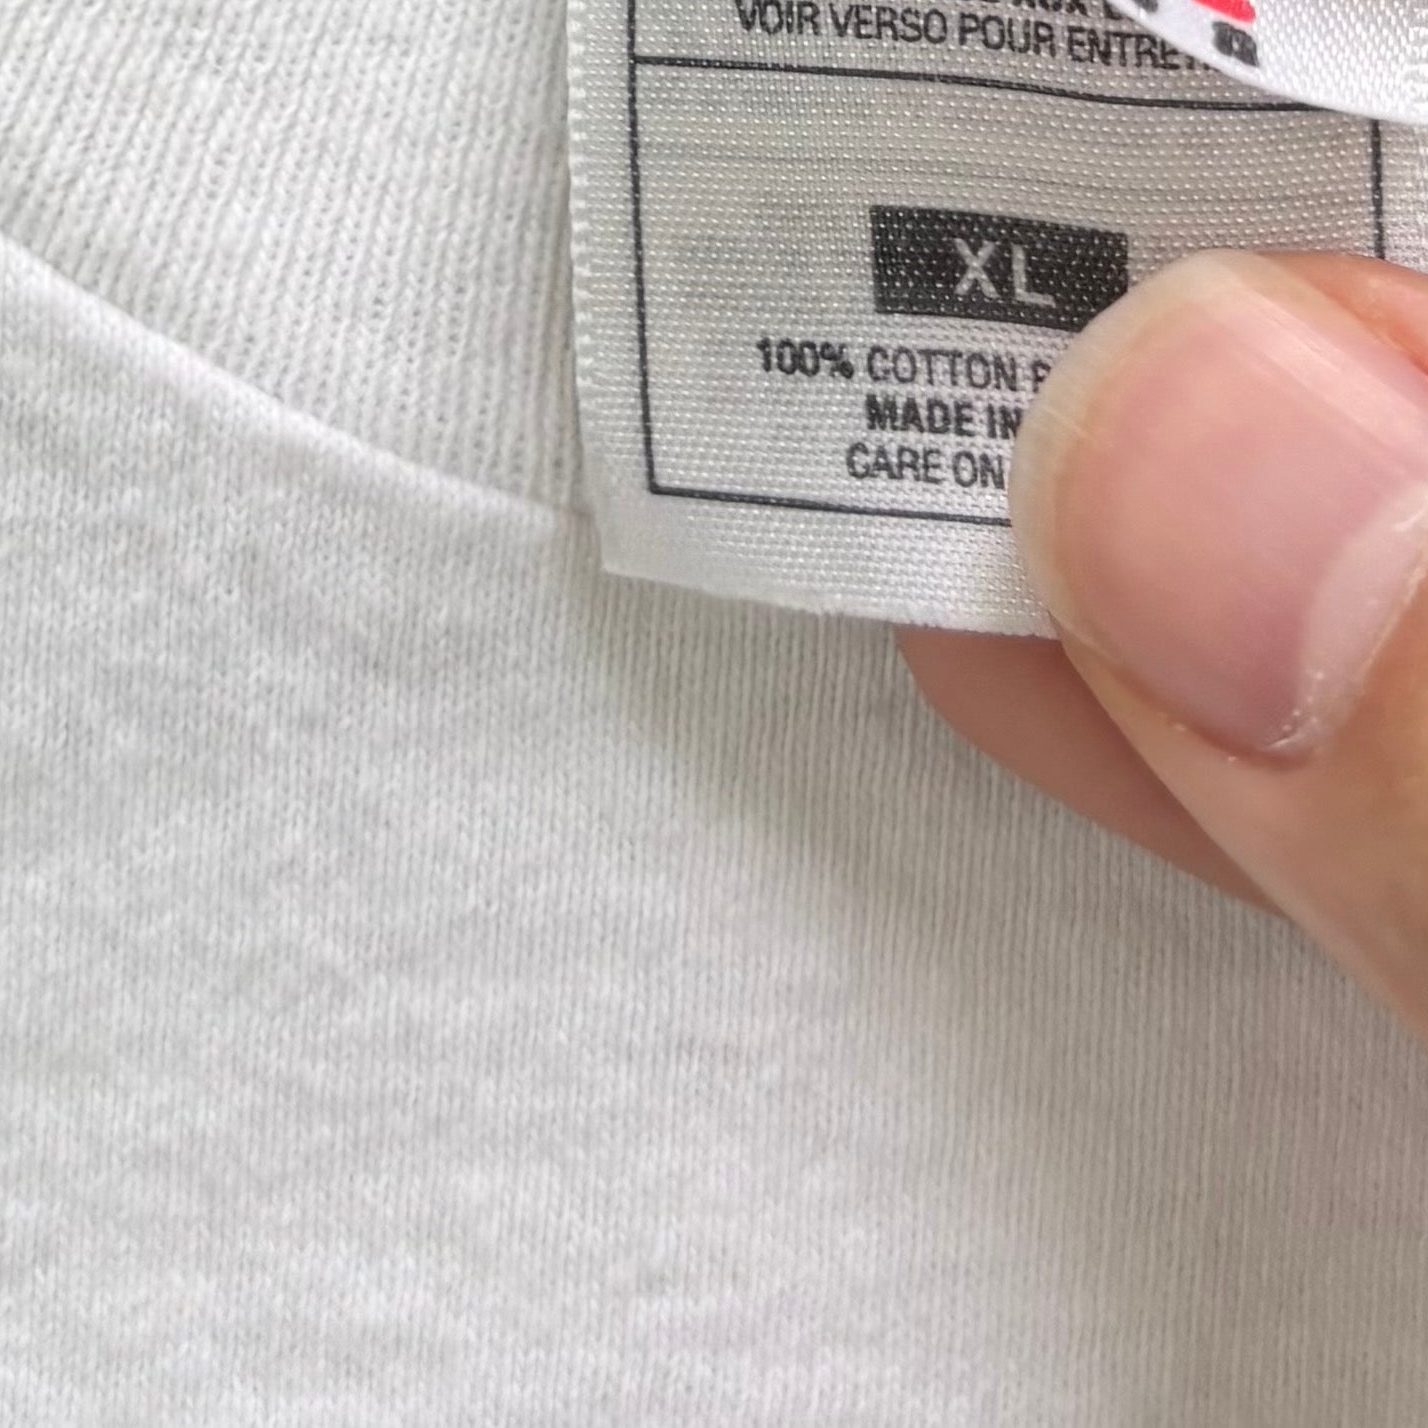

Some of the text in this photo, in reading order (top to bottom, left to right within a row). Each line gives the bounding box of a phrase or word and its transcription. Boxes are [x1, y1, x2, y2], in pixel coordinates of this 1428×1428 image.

[829, 1, 948, 45] VERSO
[957, 10, 1057, 59] POUR
[1067, 24, 1214, 72] ENTRE
[954, 237, 1057, 309] XL
[756, 336, 855, 380] 100%
[867, 345, 1019, 393] COTTON
[865, 393, 1022, 441] MADE IN
[845, 441, 1006, 491] CARE ON
